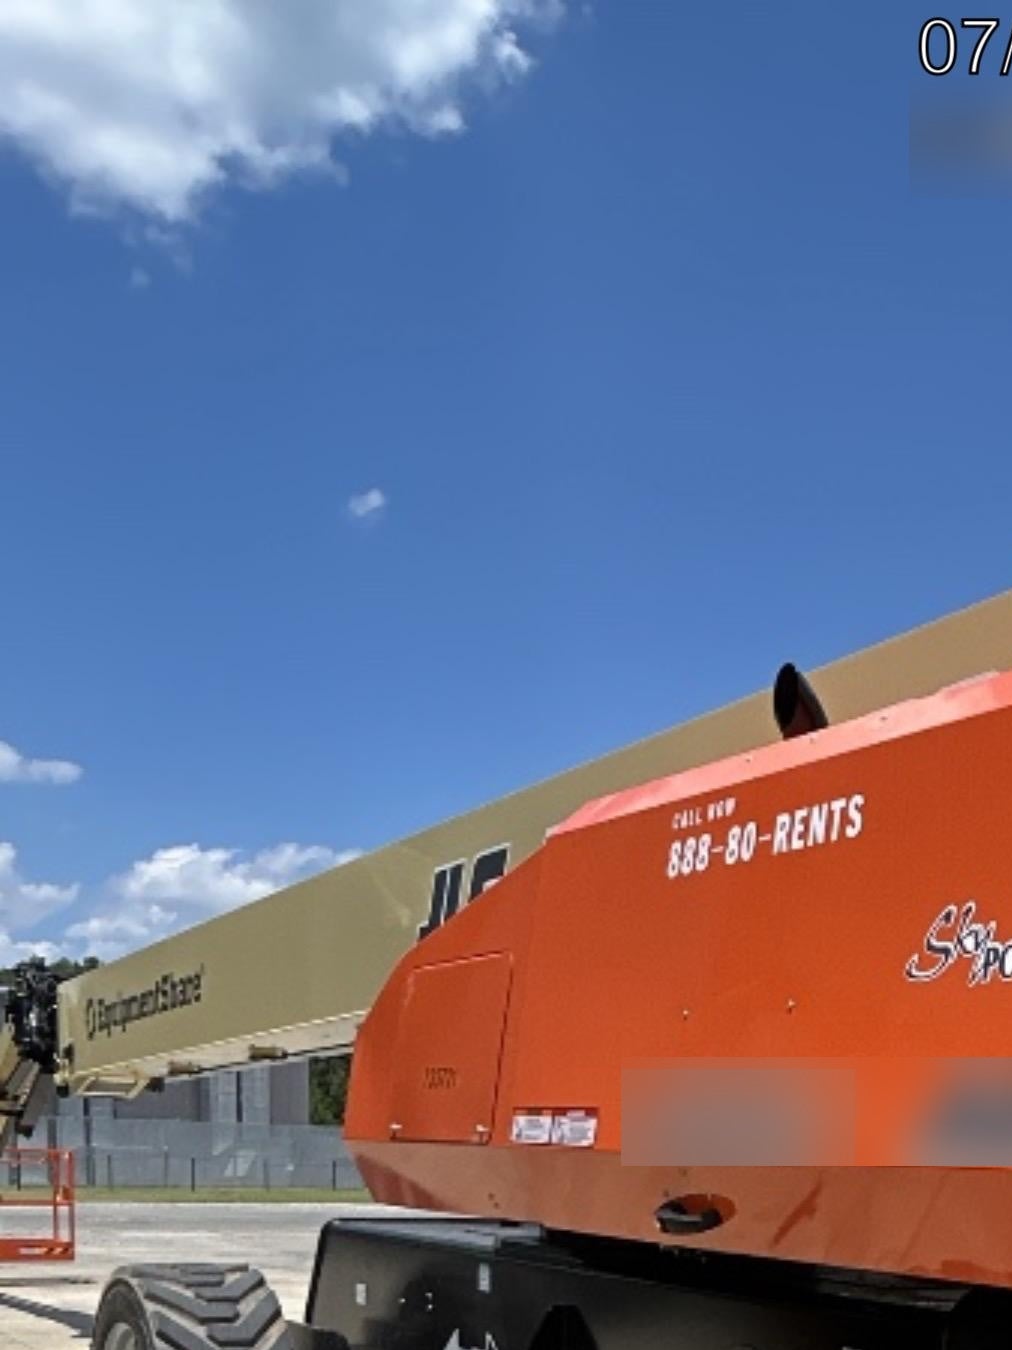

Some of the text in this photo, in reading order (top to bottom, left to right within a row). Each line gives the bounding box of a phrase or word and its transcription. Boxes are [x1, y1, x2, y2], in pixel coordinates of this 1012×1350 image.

[667, 794, 865, 880] 888-80-RENTS
[672, 797, 737, 830] CALL NOW
